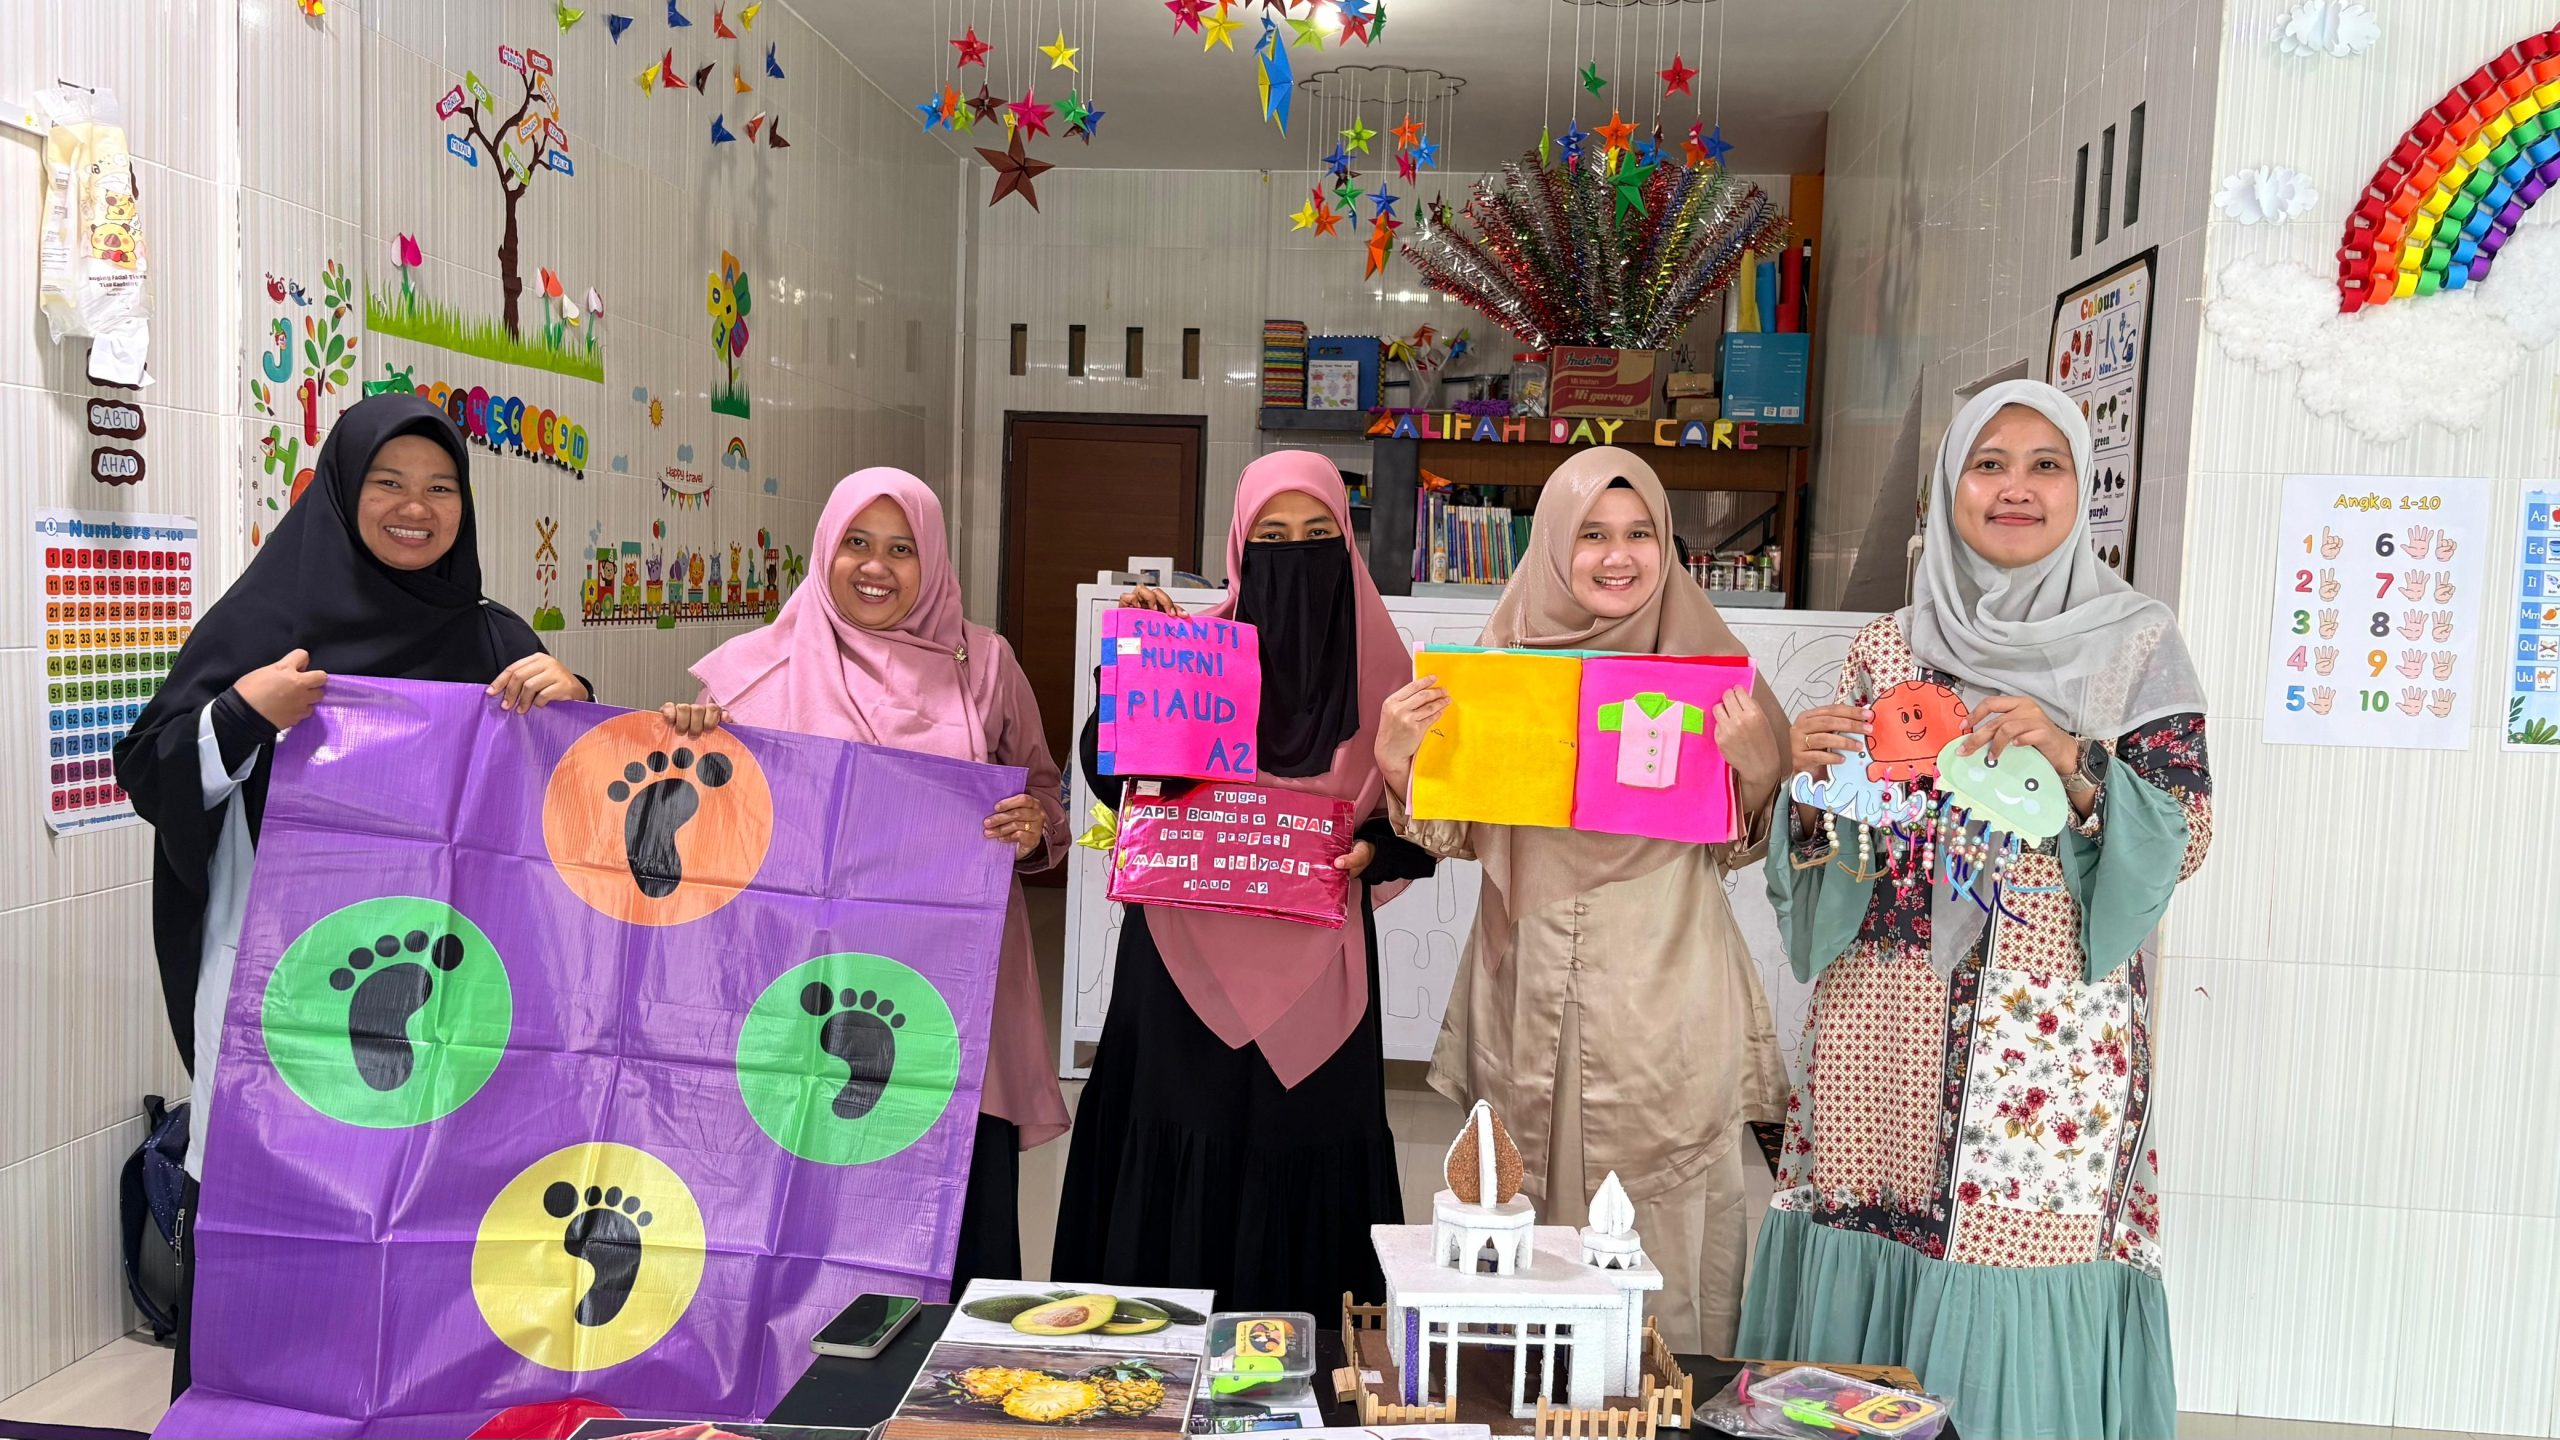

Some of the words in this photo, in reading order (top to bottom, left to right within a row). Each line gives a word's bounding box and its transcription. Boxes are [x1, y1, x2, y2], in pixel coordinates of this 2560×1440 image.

[2081, 288, 2121, 321] Colours
[263, 318, 293, 383] J
[2082, 368, 2092, 381] red
[2099, 363, 2112, 375] blue
[1589, 393, 1634, 404] goreng
[93, 406, 138, 429] SABTU
[457, 400, 464, 426] 3
[473, 400, 484, 426] 4
[493, 406, 508, 434] 5
[511, 405, 520, 436] 6
[544, 416, 553, 445] 8
[559, 423, 569, 450] 9
[573, 432, 585, 460] 10
[1392, 412, 1526, 443] ALIFAH
[1550, 416, 1624, 446] DAY
[1654, 418, 1759, 450] CARE
[2094, 435, 2110, 450] green
[101, 455, 136, 474] AHAD
[264, 425, 300, 487] H
[666, 465, 684, 481] Happy
[686, 470, 703, 483] travel
[2334, 493, 2392, 512] Angka
[2399, 496, 2442, 510] 1-10
[2089, 505, 2109, 520] purple
[2531, 510, 2548, 522] Aa
[69, 519, 151, 540] Numbers
[155, 531, 184, 541] 1-100
[2303, 535, 2313, 554] 1
[2376, 533, 2395, 557] 6
[2529, 543, 2545, 555] Ee
[51, 554, 56, 563] 1
[66, 554, 72, 563] 2
[82, 554, 87, 564] 3
[97, 554, 103, 564] 4
[112, 555, 118, 564] 5
[127, 555, 132, 565] 6
[142, 556, 147, 565] 7
[155, 556, 161, 566] 8
[169, 557, 174, 566] 9
[180, 557, 189, 566] 10
[49, 581, 58, 591] 11
[65, 581, 74, 591] 12
[80, 581, 89, 591] 13
[96, 581, 105, 591] 14
[111, 581, 120, 591] 15
[125, 582, 135, 591] 16
[140, 582, 148, 591] 17
[155, 582, 163, 591] 18
[168, 582, 176, 591] 19
[181, 582, 190, 591] 20
[2295, 570, 2313, 593] 2
[2376, 573, 2395, 599] 7
[49, 608, 58, 618] 21
[64, 608, 74, 617] 22
[80, 607, 90, 617] 23
[96, 607, 105, 617] 24
[111, 607, 120, 617] 25
[125, 607, 135, 616] 26
[140, 607, 149, 616] 27
[154, 606, 163, 616] 28
[168, 606, 176, 615] 29
[181, 606, 190, 615] 30
[2522, 609, 2540, 620] Mm
[2291, 610, 2311, 635] 3
[2370, 612, 2390, 638] 8
[49, 635, 59, 645] 31
[65, 634, 75, 644] 32
[81, 633, 91, 644] 33
[96, 633, 106, 643] 34
[111, 633, 121, 643] 35
[126, 632, 135, 642] 36
[141, 632, 149, 642] 37
[155, 631, 164, 641] 38
[168, 631, 177, 641] 39
[1132, 620, 1239, 648] SUKANTI
[2520, 640, 2537, 652] Qu
[51, 661, 60, 672] 41
[66, 661, 76, 671] 42
[82, 660, 92, 670] 43
[97, 660, 107, 670] 44
[112, 659, 122, 669] 45
[126, 658, 136, 668] 46
[141, 657, 150, 667] 47
[155, 656, 164, 666] 48
[1142, 647, 1223, 677] MURNI
[2287, 646, 2308, 672] 4
[2367, 650, 2388, 678] 9
[2517, 672, 2534, 683] Uu
[51, 688, 61, 699] 51
[67, 687, 77, 698] 52
[82, 686, 92, 697] 53
[98, 685, 107, 696] 54
[113, 684, 122, 695] 55
[127, 684, 137, 694] 56
[142, 682, 150, 693] 57
[2285, 685, 2306, 712] 5
[1128, 689, 1236, 724] PIAUD
[2360, 690, 2390, 713] 10
[52, 716, 62, 726] 61
[68, 715, 78, 725] 62
[83, 713, 93, 723] 63
[98, 712, 108, 722] 64
[113, 710, 123, 720] 65
[128, 709, 137, 719] 66
[53, 743, 62, 753] 71
[68, 741, 78, 751] 72
[84, 740, 93, 750] 73
[99, 738, 108, 748] 74
[1206, 738, 1254, 774] A2
[55, 796, 64, 806] 91
[70, 795, 80, 805] 92
[86, 792, 95, 802] 93
[100, 789, 111, 800] 94
[1142, 807, 1178, 818] APE
[1188, 809, 1265, 823] Bahasa
[1248, 883, 1268, 893] A2
